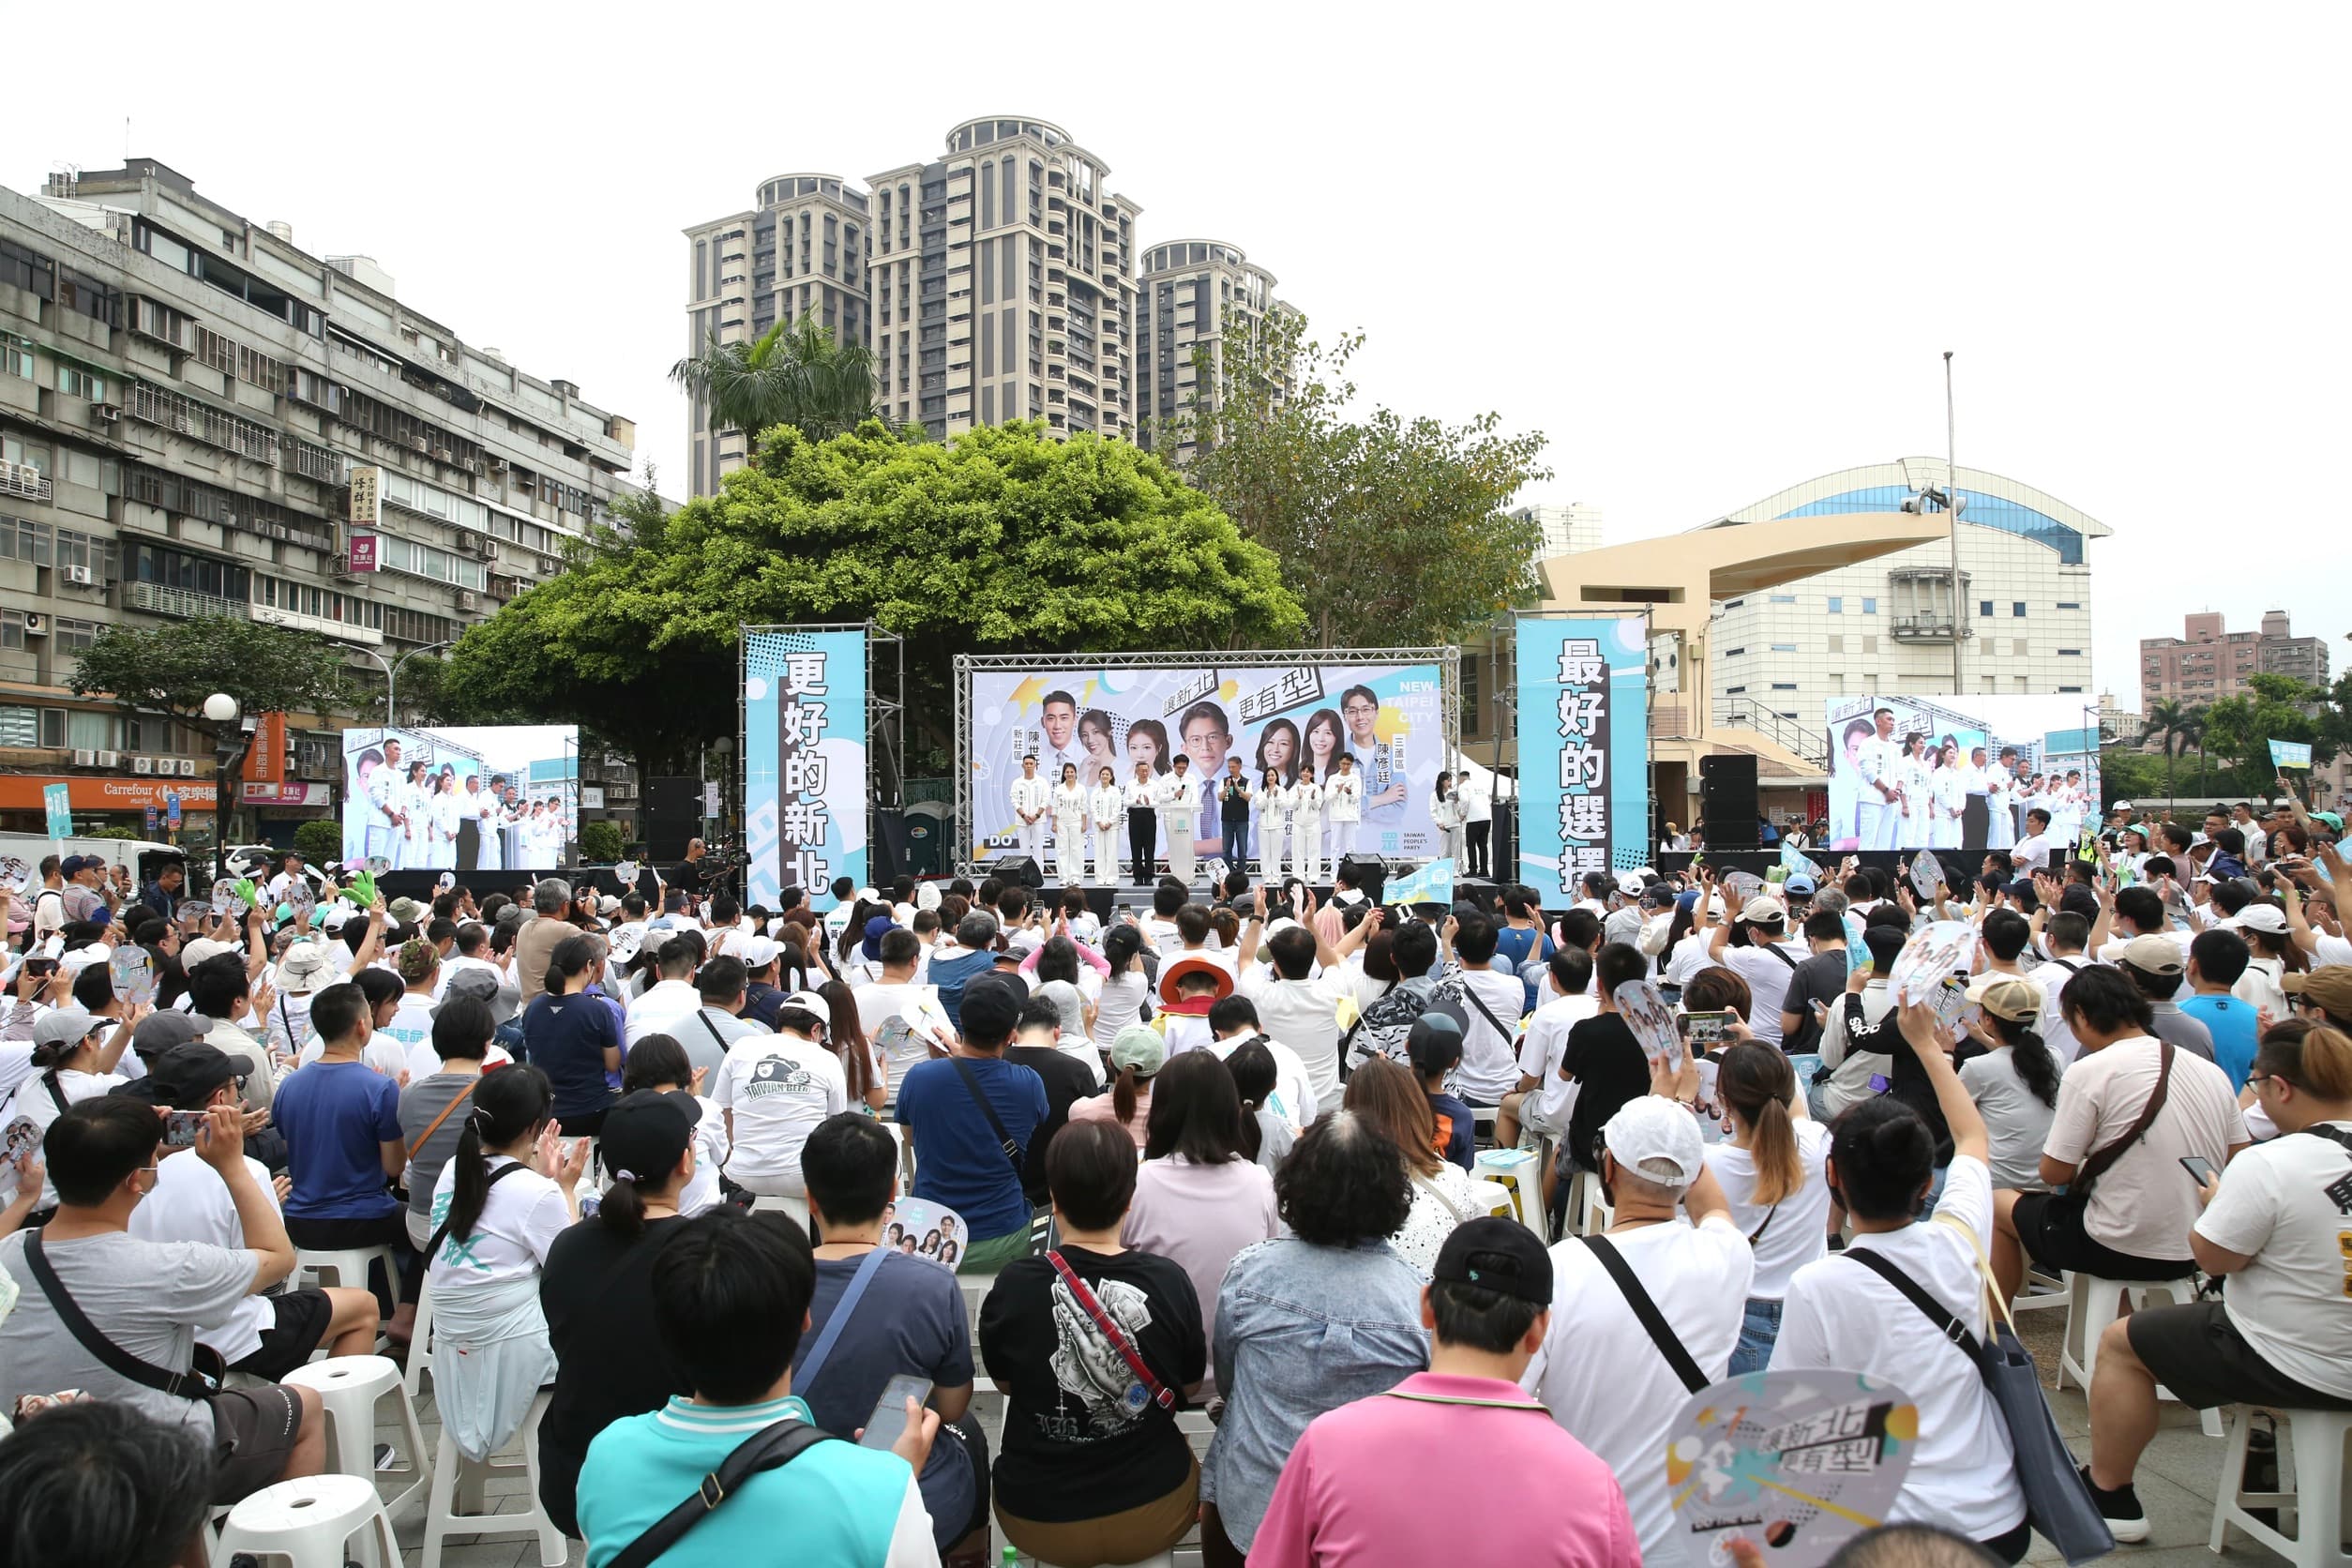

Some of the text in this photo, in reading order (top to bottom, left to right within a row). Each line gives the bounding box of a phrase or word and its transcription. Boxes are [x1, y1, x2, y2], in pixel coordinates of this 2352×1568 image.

[1163, 671, 1214, 716] 讓新北
[1239, 667, 1319, 723] 更有型
[1400, 681, 1434, 692] NEW
[1387, 697, 1434, 708] TAIPEI
[1398, 712, 1434, 723] CITY
[1013, 729, 1023, 761] 新莊區
[1378, 743, 1390, 783] 陳彥廷
[1558, 639, 1606, 893] 最好的選擇
[784, 652, 829, 896] 更好的新北
[104, 782, 153, 796] Carrefour
[177, 785, 218, 801] 家樂福
[989, 834, 1012, 847] DO
[744, 1082, 784, 1100] TAIWAN
